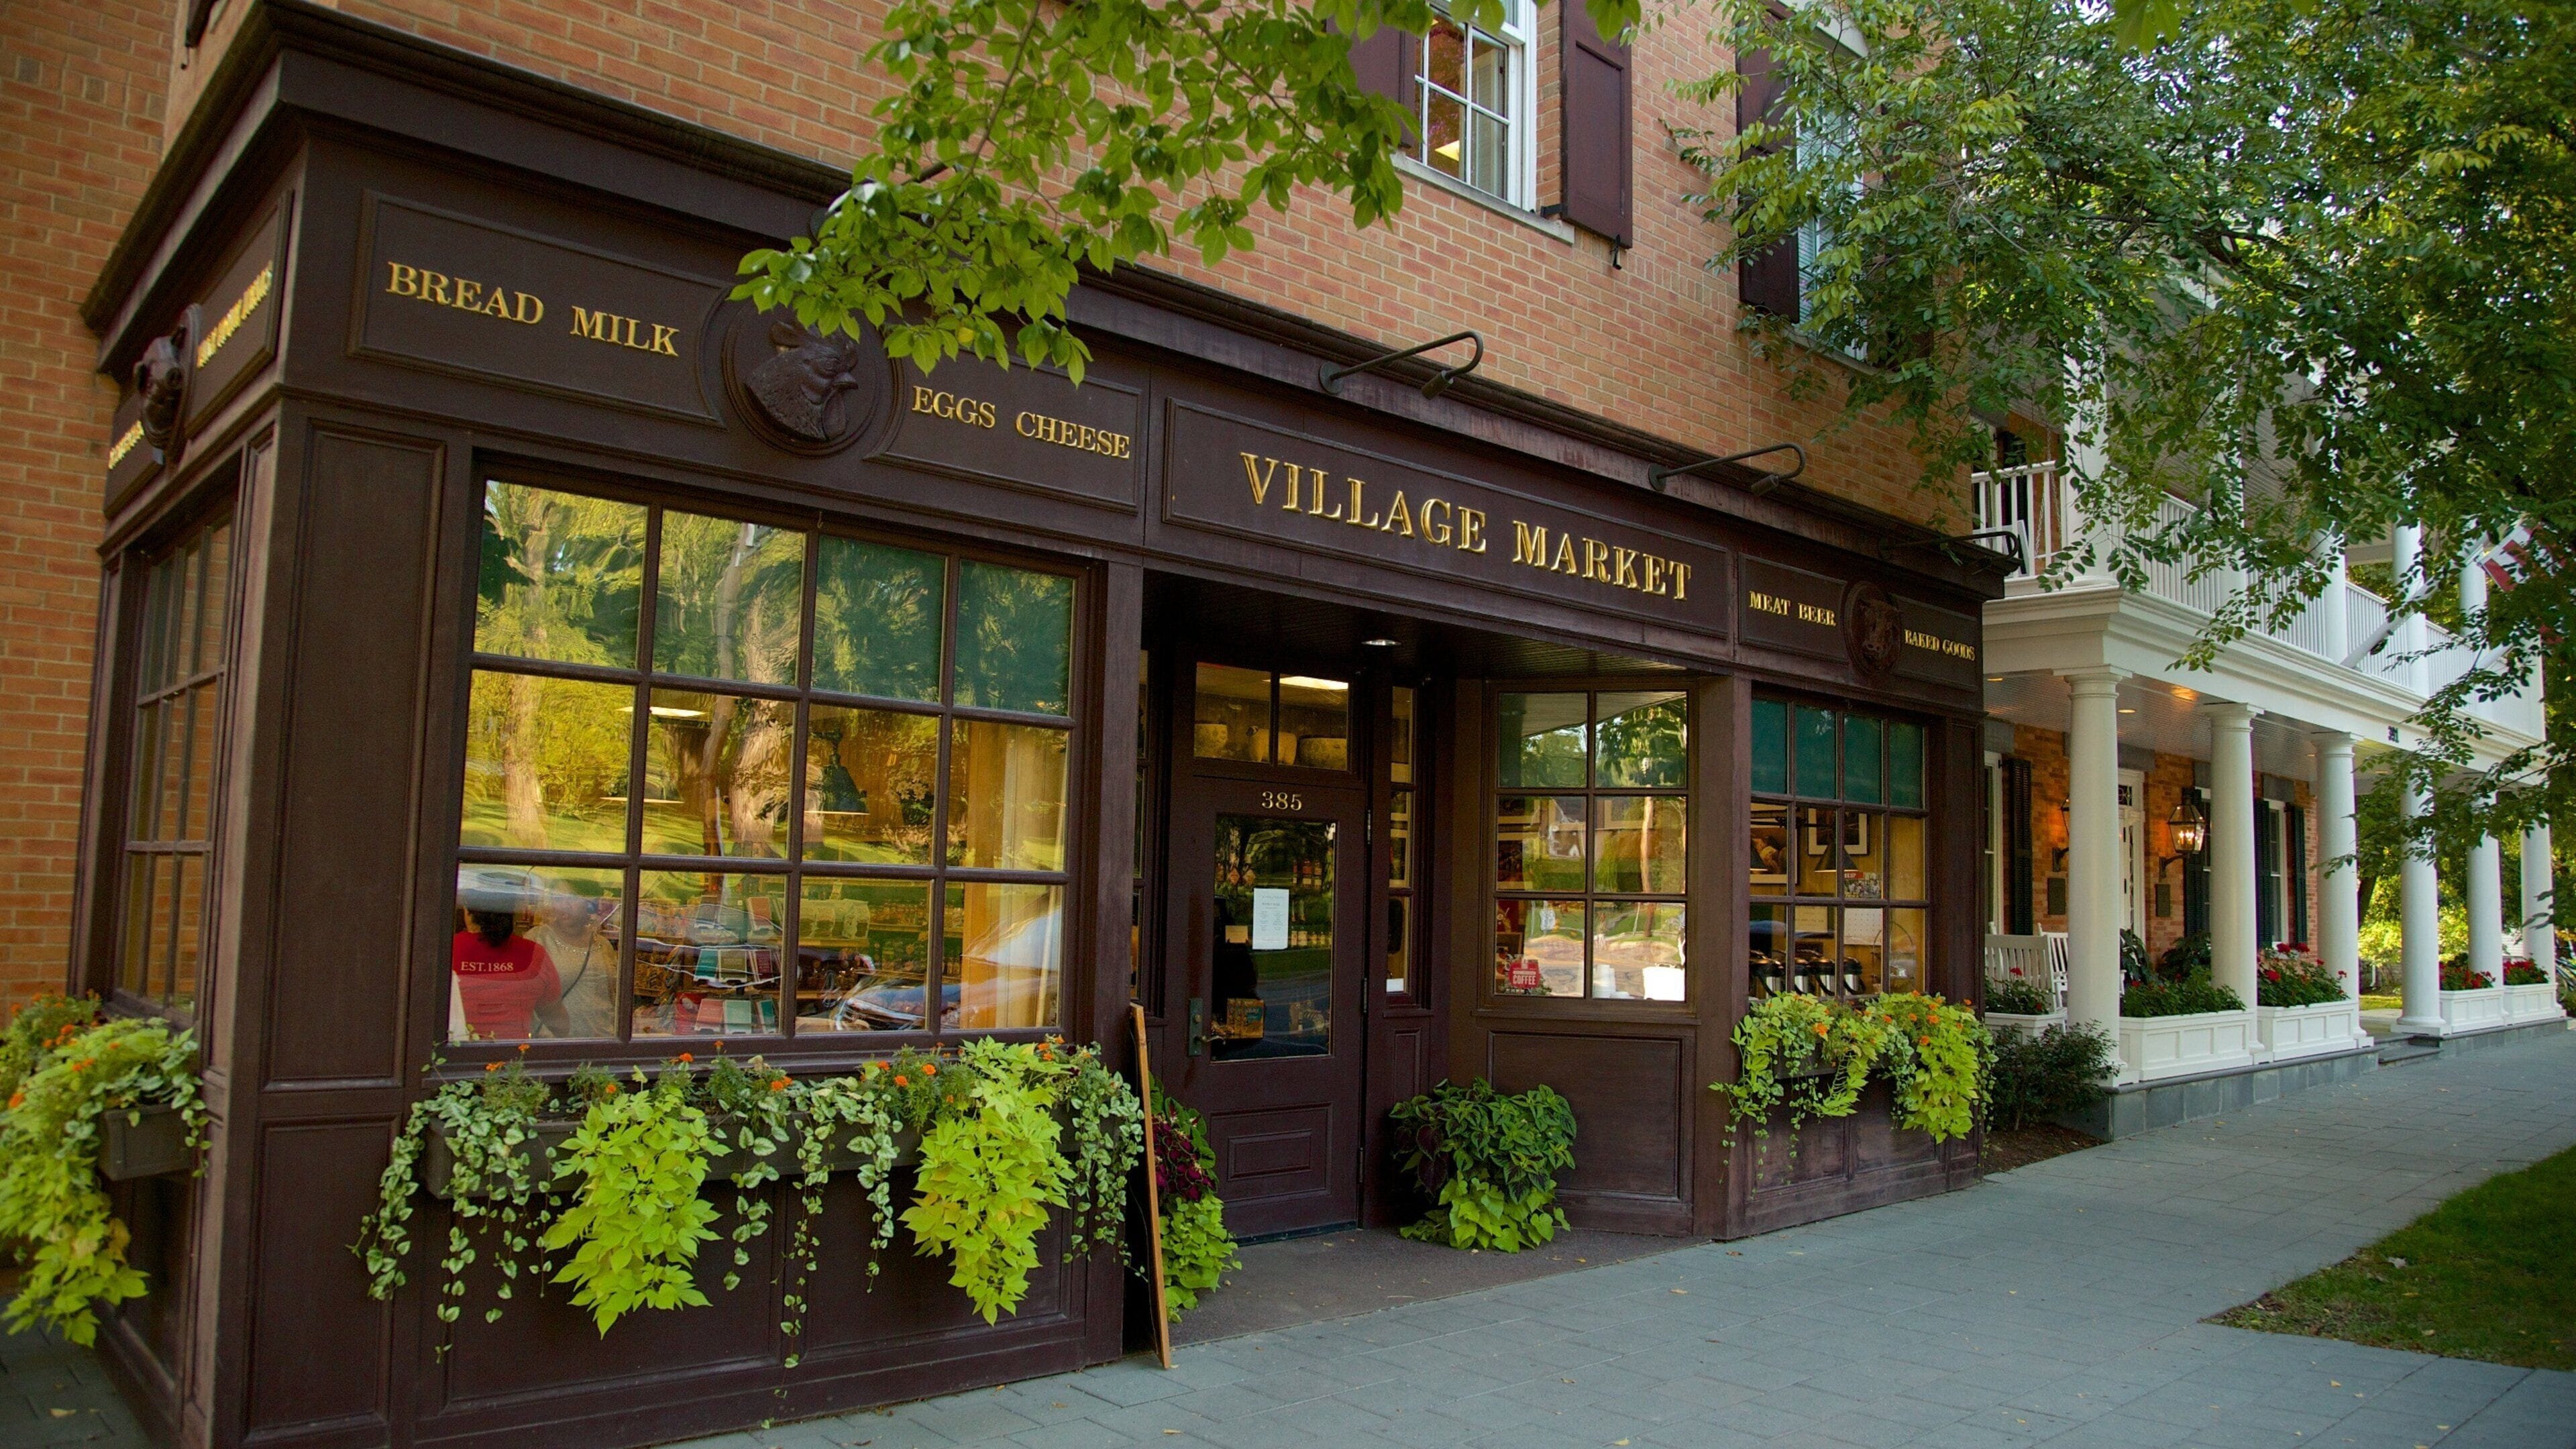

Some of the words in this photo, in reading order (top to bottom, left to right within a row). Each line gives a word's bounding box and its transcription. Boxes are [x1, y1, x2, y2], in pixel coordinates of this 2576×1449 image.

[384, 262, 544, 324] BREAD
[570, 306, 680, 357] MILK
[912, 386, 996, 429] EGGS
[1016, 411, 1130, 459] CHEESE
[1240, 451, 1487, 555] VILLAGE
[1512, 521, 1691, 600] MARKET
[1749, 591, 1791, 616] MEAT
[1798, 602, 1836, 627] BEER
[1904, 629, 1940, 652] BAKED
[1942, 639, 1976, 661] GOODS
[1261, 791, 1303, 811] 385
[1513, 974, 1536, 985] COFFEE
